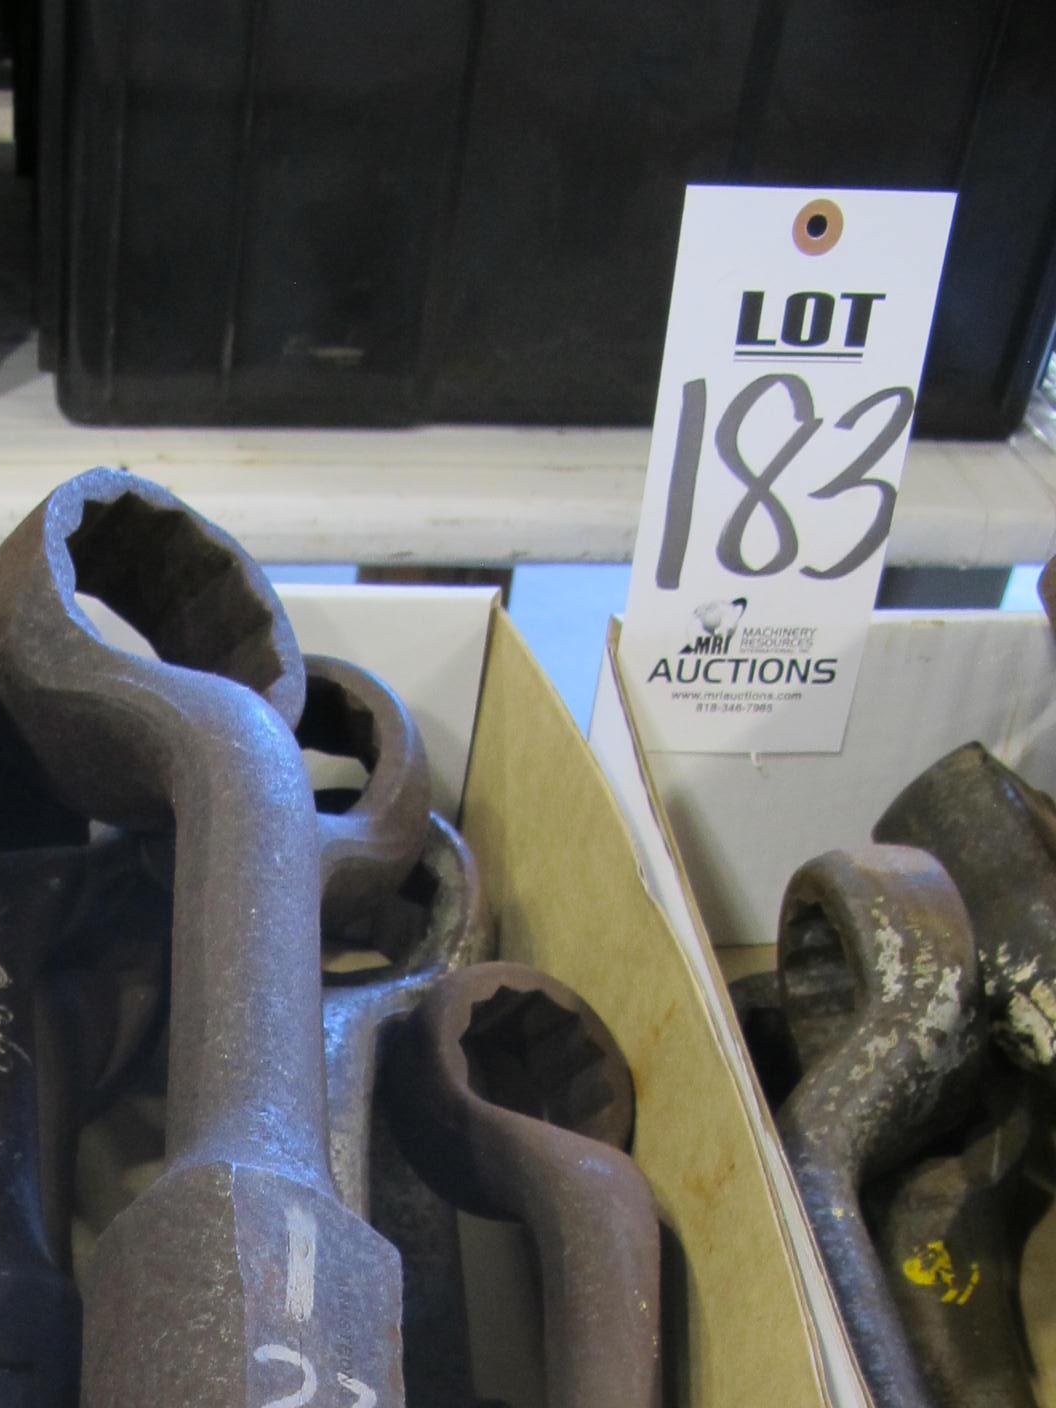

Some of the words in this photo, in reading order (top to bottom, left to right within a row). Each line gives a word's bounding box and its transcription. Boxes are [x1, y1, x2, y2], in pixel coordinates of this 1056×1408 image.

[734, 289, 887, 348] LOT
[654, 372, 917, 591] 183
[693, 632, 734, 654] MRI
[740, 637, 815, 648] RESOURCES
[742, 627, 818, 638] MACHINERY
[647, 657, 839, 685] AUCTIONS
